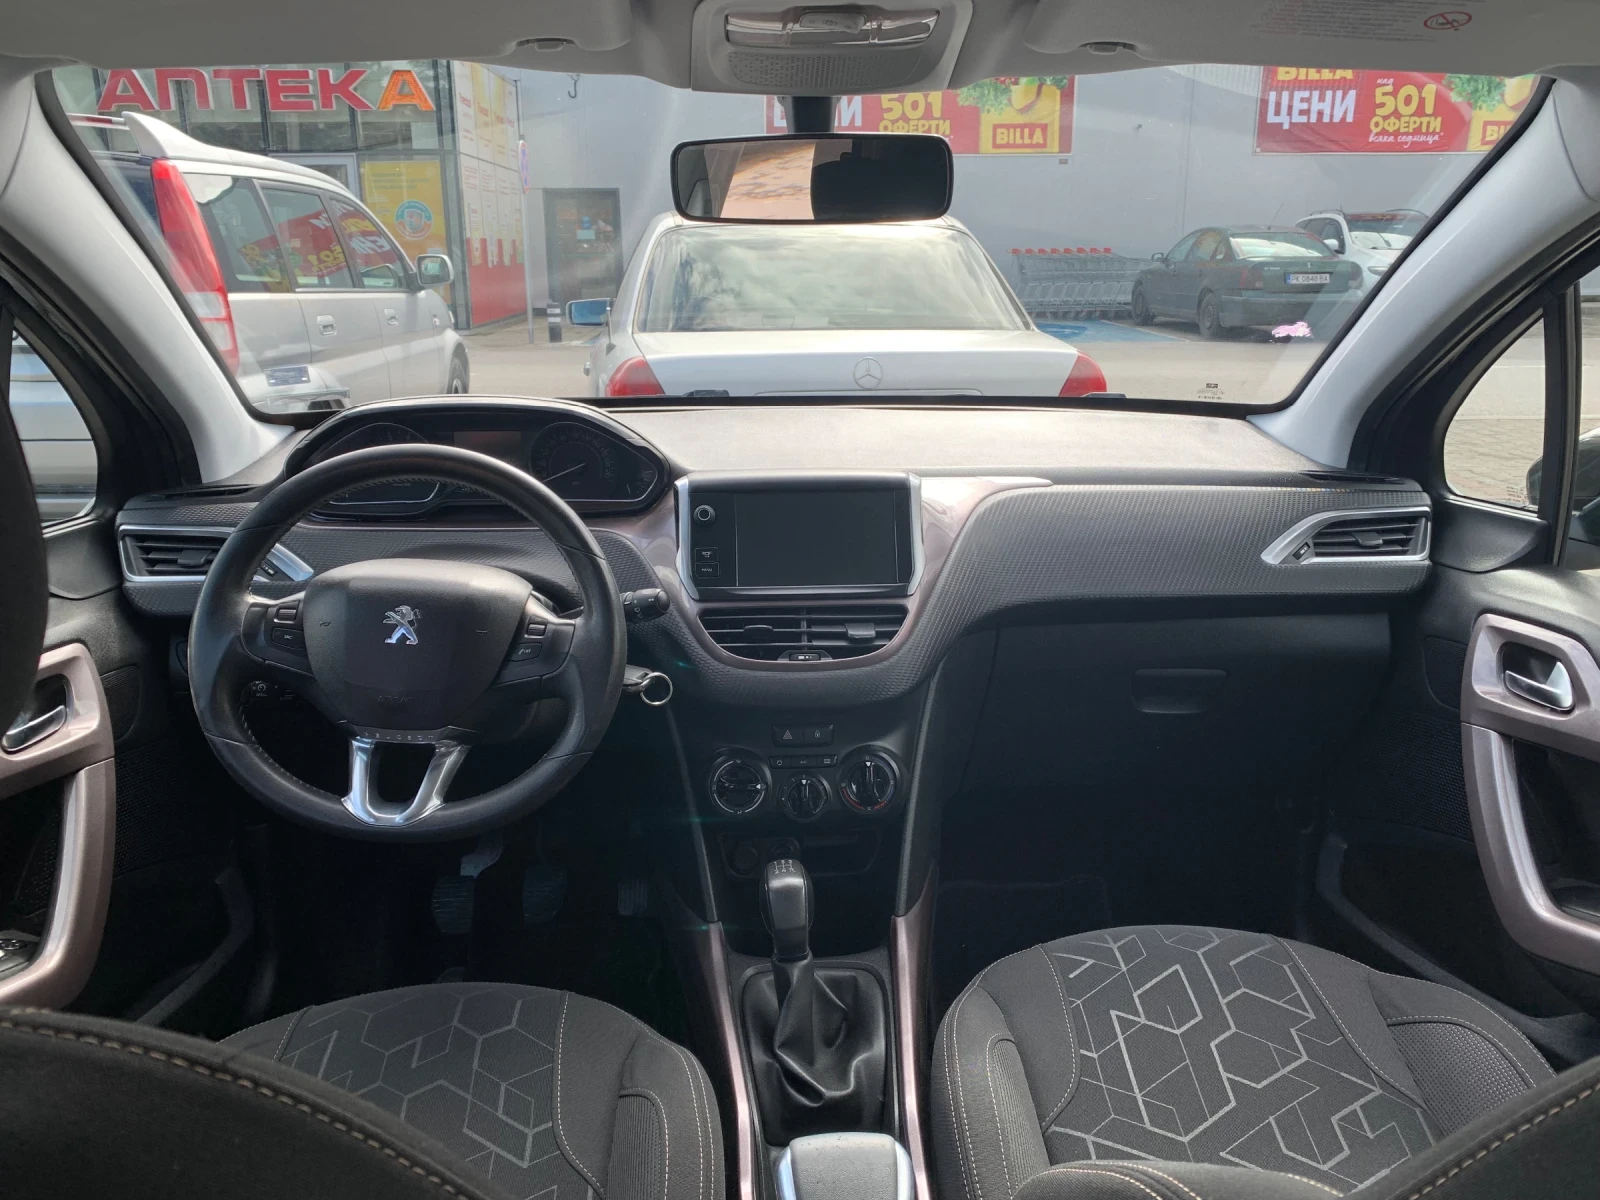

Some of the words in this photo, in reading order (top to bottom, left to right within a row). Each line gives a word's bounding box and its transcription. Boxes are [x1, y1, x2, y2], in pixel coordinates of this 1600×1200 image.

[96, 68, 436, 111] АПТЕКА
[1375, 84, 1437, 116] 501
[881, 91, 943, 120] 501
[1266, 90, 1357, 129] ЦЕНИ
[878, 119, 951, 135] ОФЕРТИ
[995, 127, 1045, 145] BILLA
[1369, 115, 1442, 133] ОФЕРТИ
